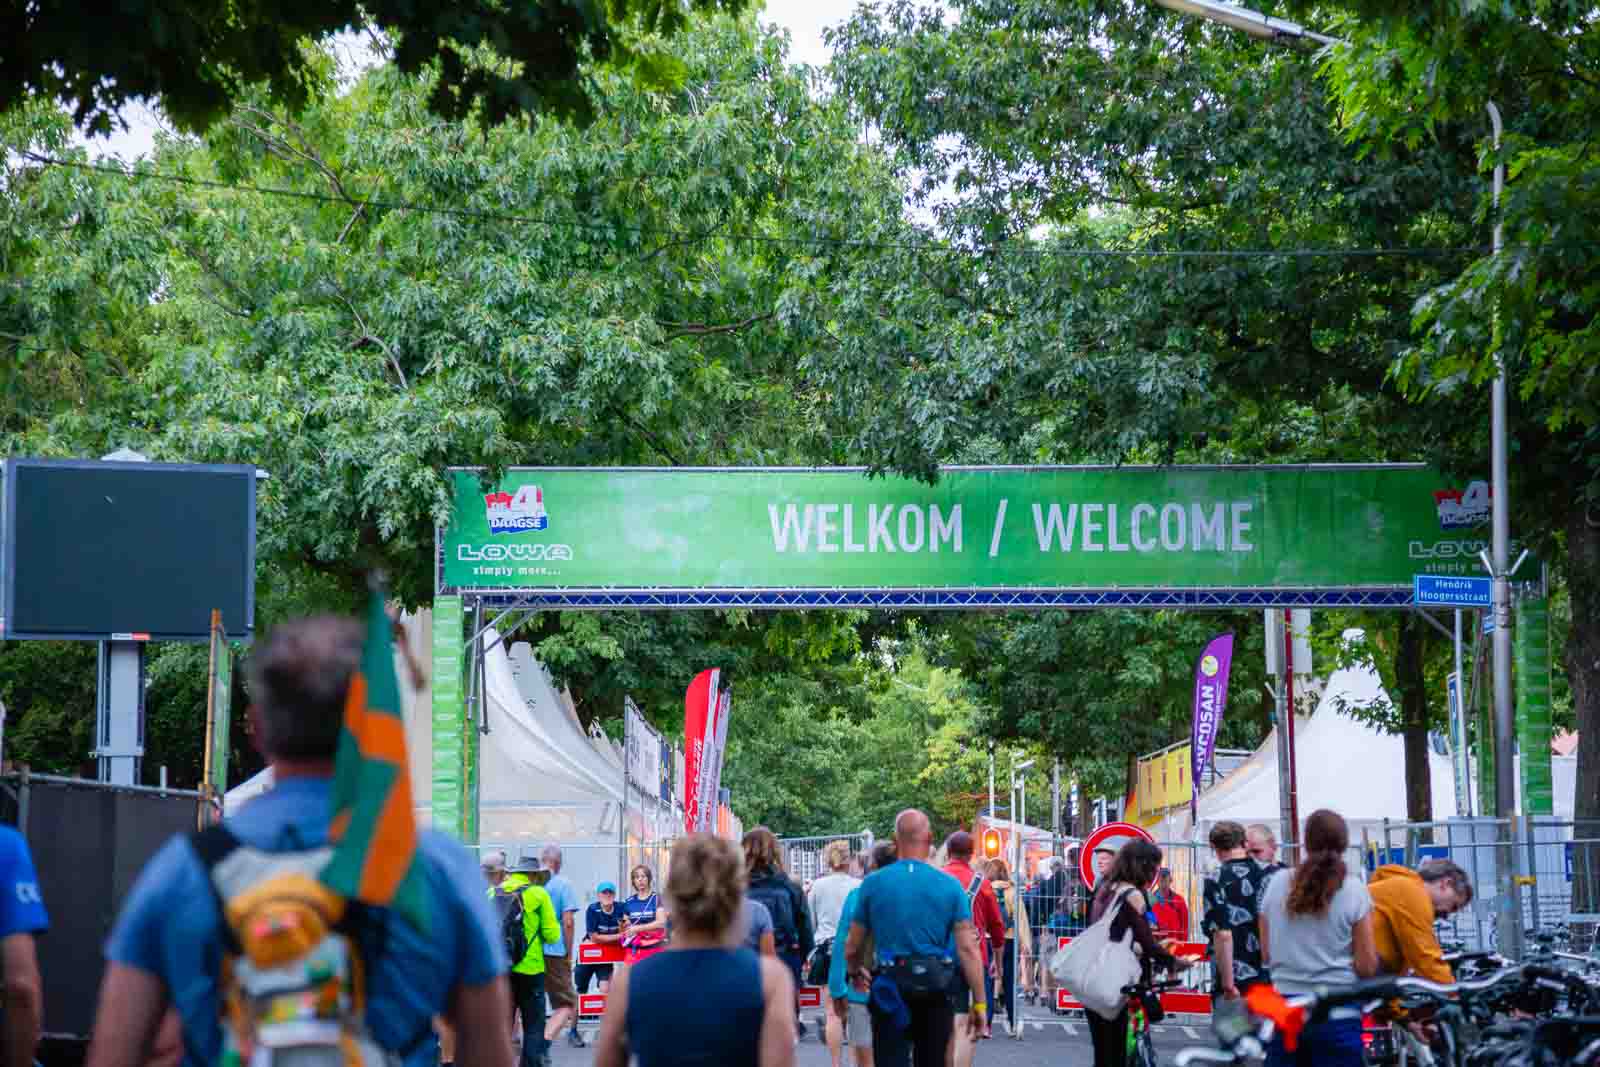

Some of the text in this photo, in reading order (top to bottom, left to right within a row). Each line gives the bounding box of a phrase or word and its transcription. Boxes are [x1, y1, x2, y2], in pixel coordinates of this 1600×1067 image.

[491, 517, 542, 528] DAAGSE
[768, 499, 1253, 556] WELKOM / WELCOME
[458, 544, 573, 560] LOWA
[473, 566, 513, 576] simply
[1435, 580, 1473, 589] Hendrik
